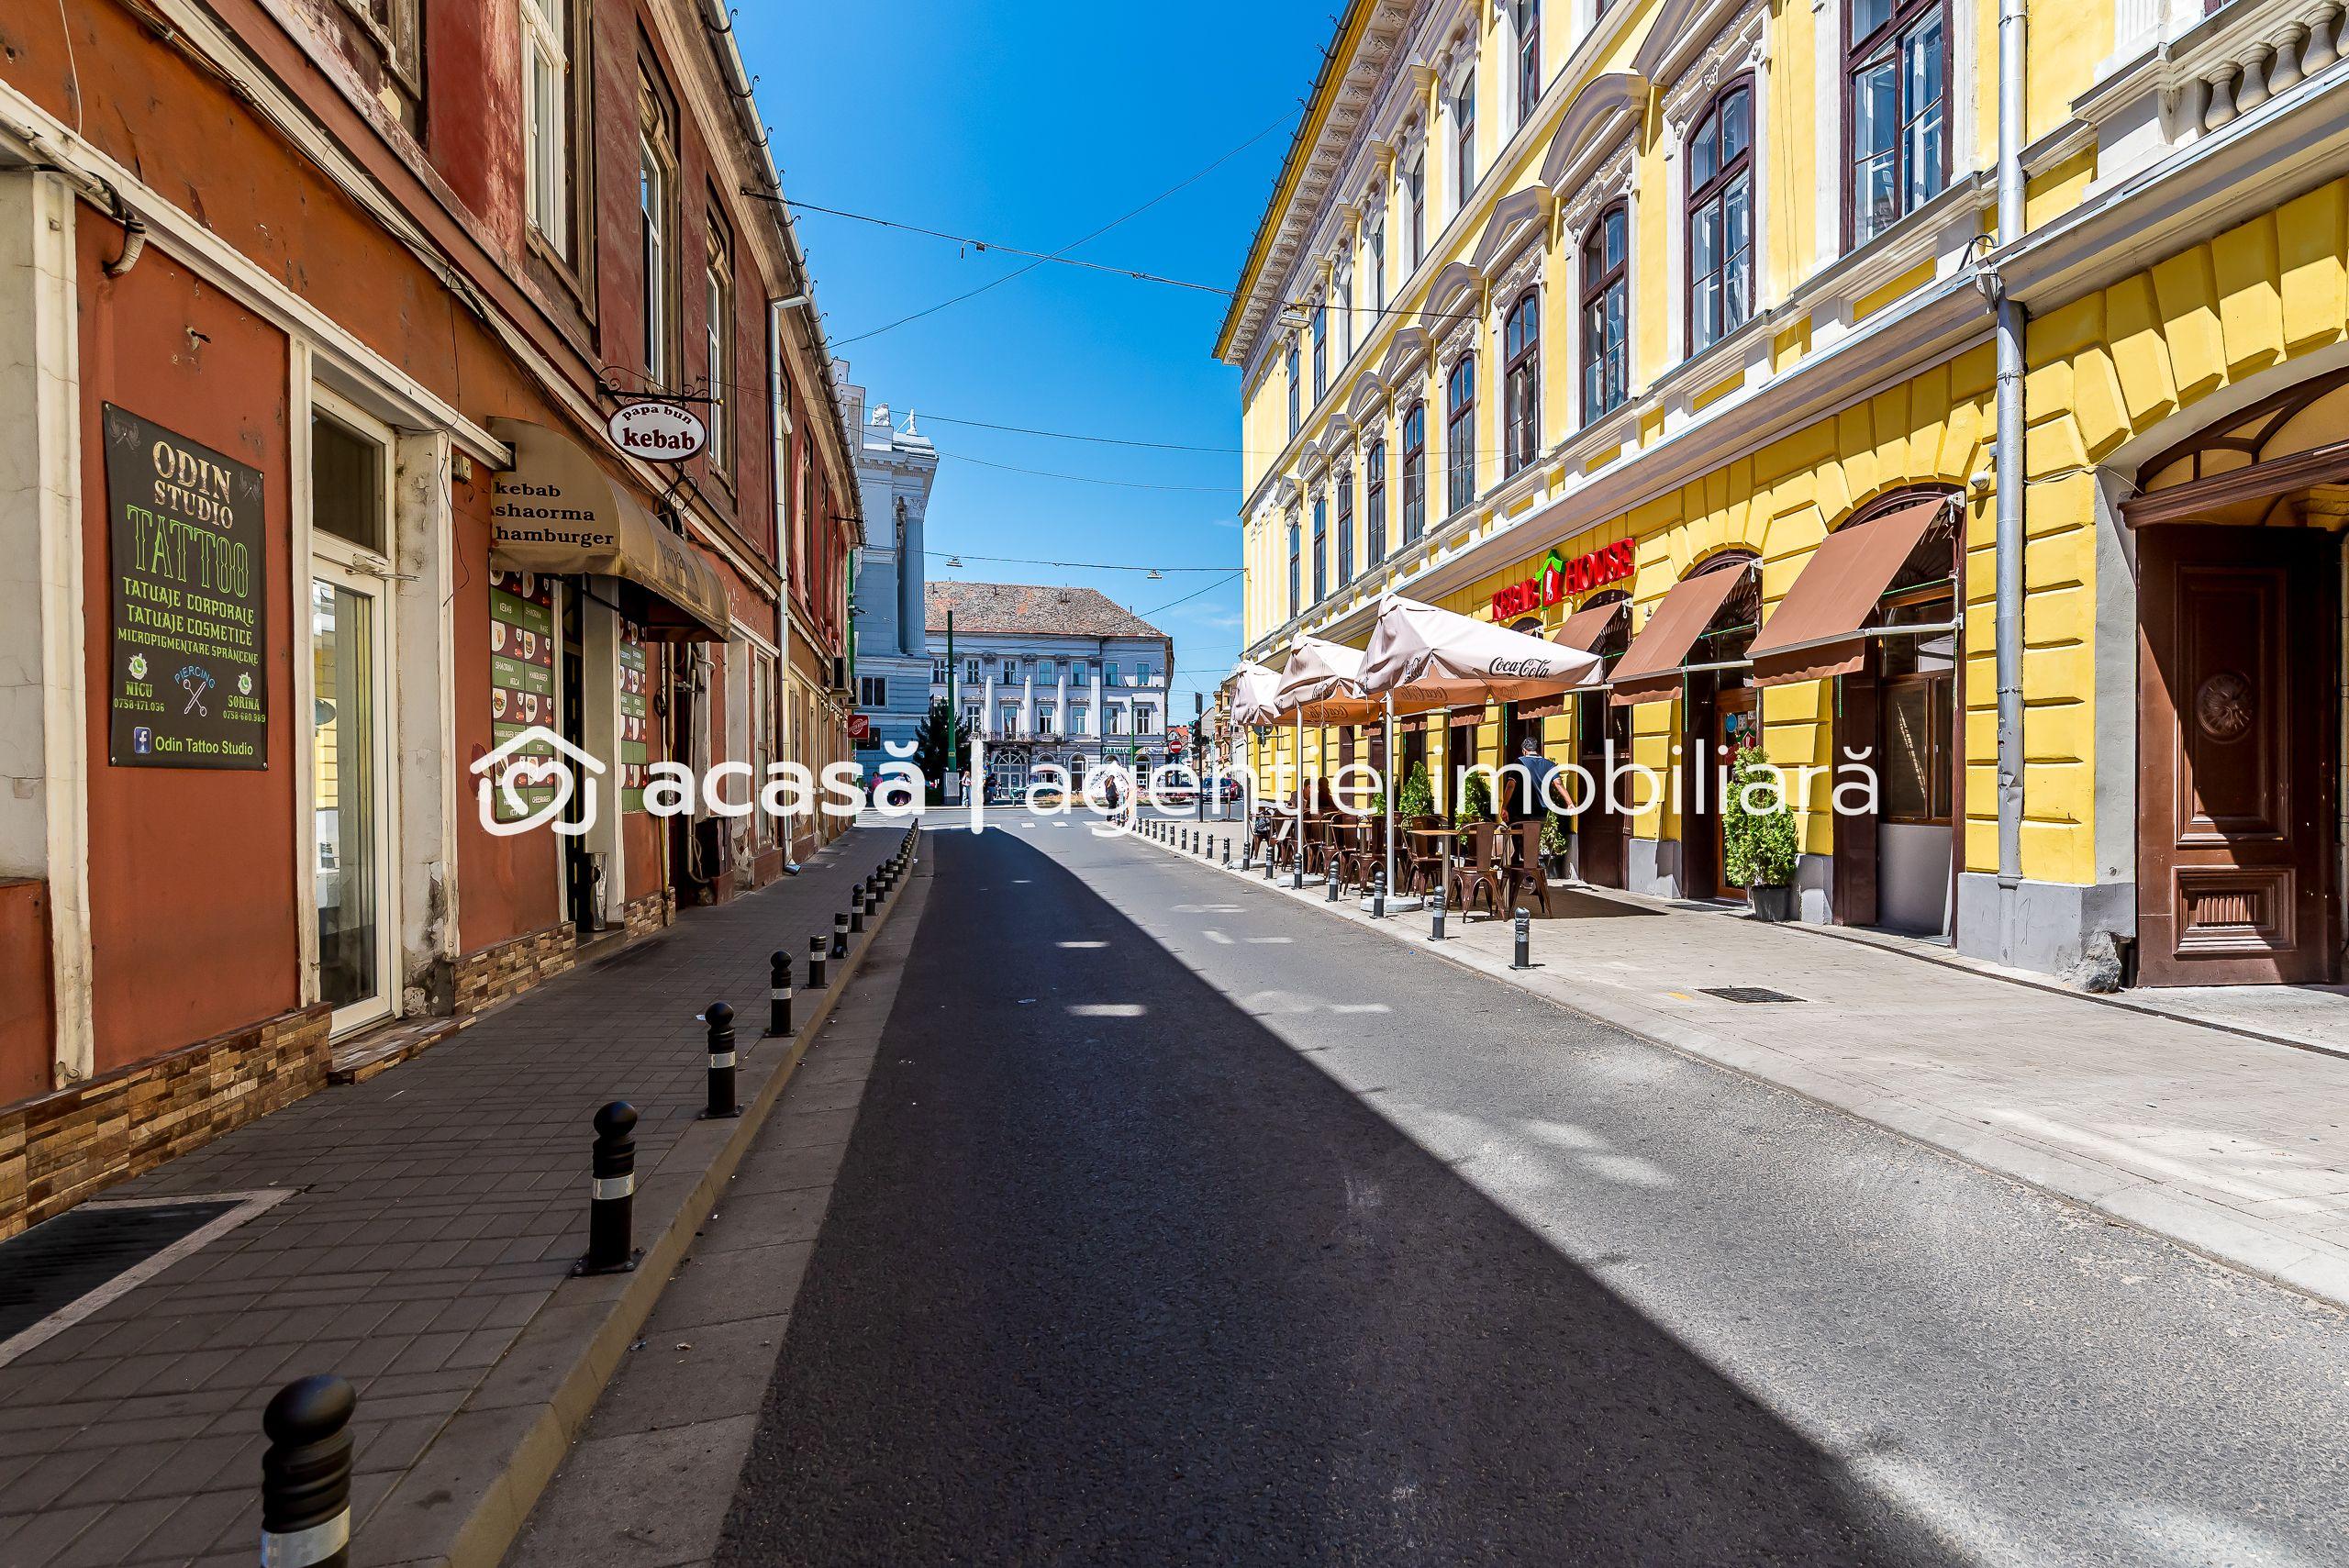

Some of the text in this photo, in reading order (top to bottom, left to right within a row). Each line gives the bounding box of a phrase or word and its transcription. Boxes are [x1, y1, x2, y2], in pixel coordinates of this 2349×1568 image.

[622, 406, 693, 425] papa bun
[622, 428, 696, 450] kebab
[152, 440, 232, 505] ODIN
[495, 481, 562, 498] kebab
[154, 479, 234, 529] STUDIO
[495, 503, 596, 521] shaorma
[495, 526, 615, 549] hamburger
[127, 504, 250, 598] TATTOO
[1564, 538, 1636, 595] HOUSE
[122, 576, 255, 628] TATUAJE CORPORALE
[126, 603, 253, 647] TATUAJE COSMETICE
[117, 627, 259, 667] MICROPIGMENTARE SPRÂNCENE
[174, 665, 216, 689] PIERCING
[1489, 656, 1551, 679] Coca-Cola
[126, 682, 153, 697] NICU
[228, 695, 261, 711] SORINA
[155, 736, 183, 752] Odin
[185, 738, 219, 754] Tattoo
[221, 740, 253, 756] Studio
